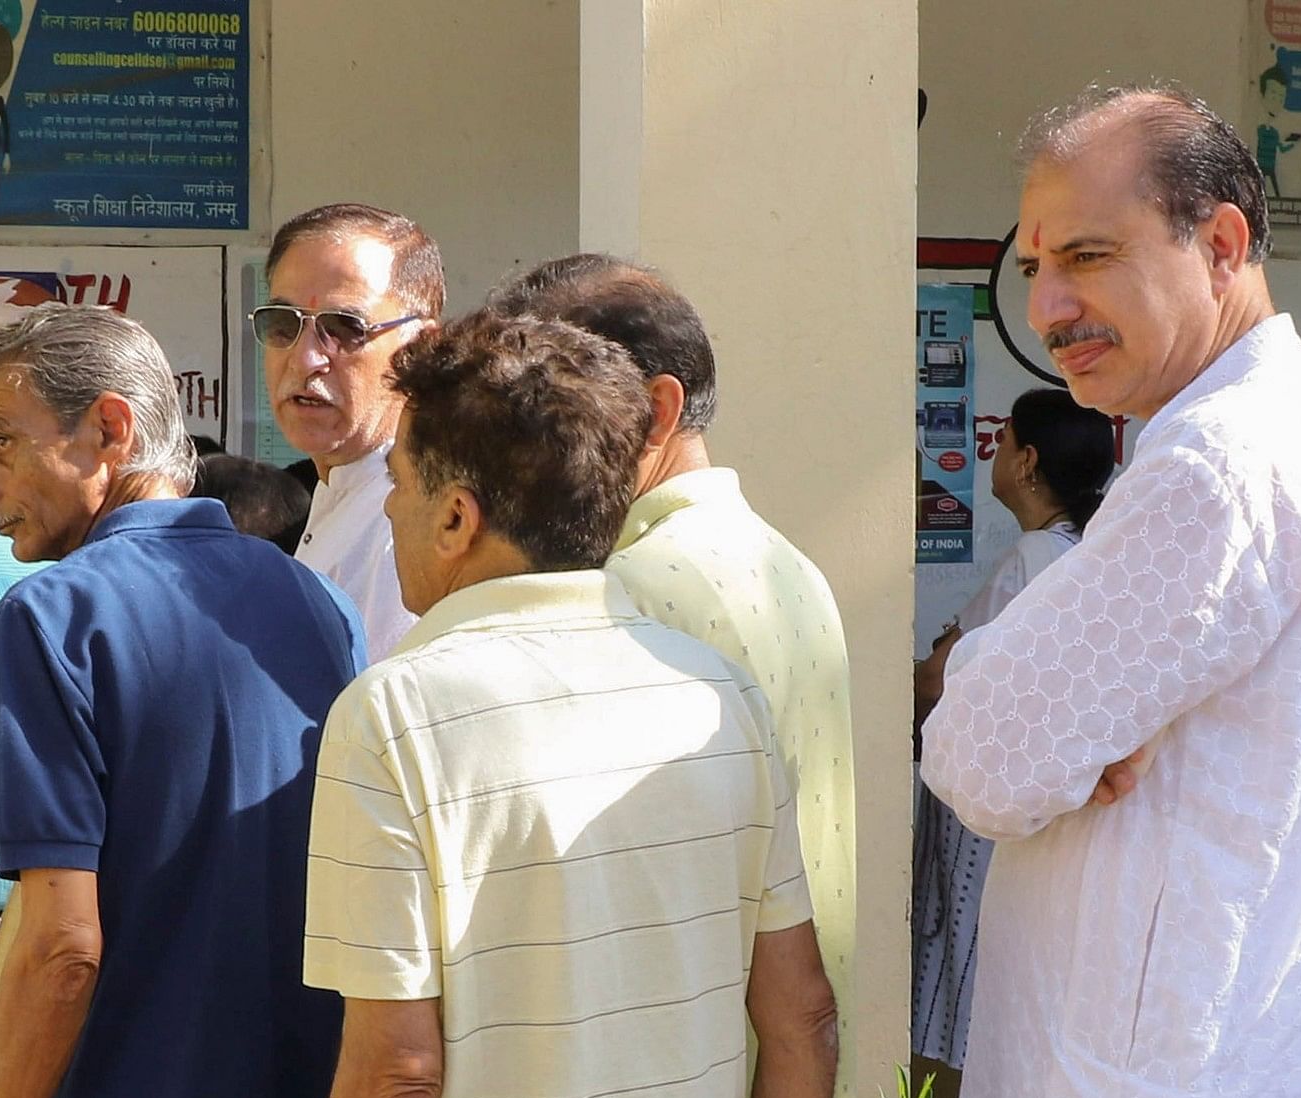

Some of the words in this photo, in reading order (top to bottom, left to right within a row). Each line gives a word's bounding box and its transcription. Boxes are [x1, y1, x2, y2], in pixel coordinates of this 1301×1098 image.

[133, 11, 241, 35] 6006800068
[53, 198, 89, 222] स्कूल
[93, 194, 127, 217] शिक्षा
[204, 201, 240, 225] जम्मू
[916, 309, 948, 338] TE
[173, 370, 220, 421] TH
[920, 538, 934, 549] OF
[936, 538, 965, 549] INDIA
